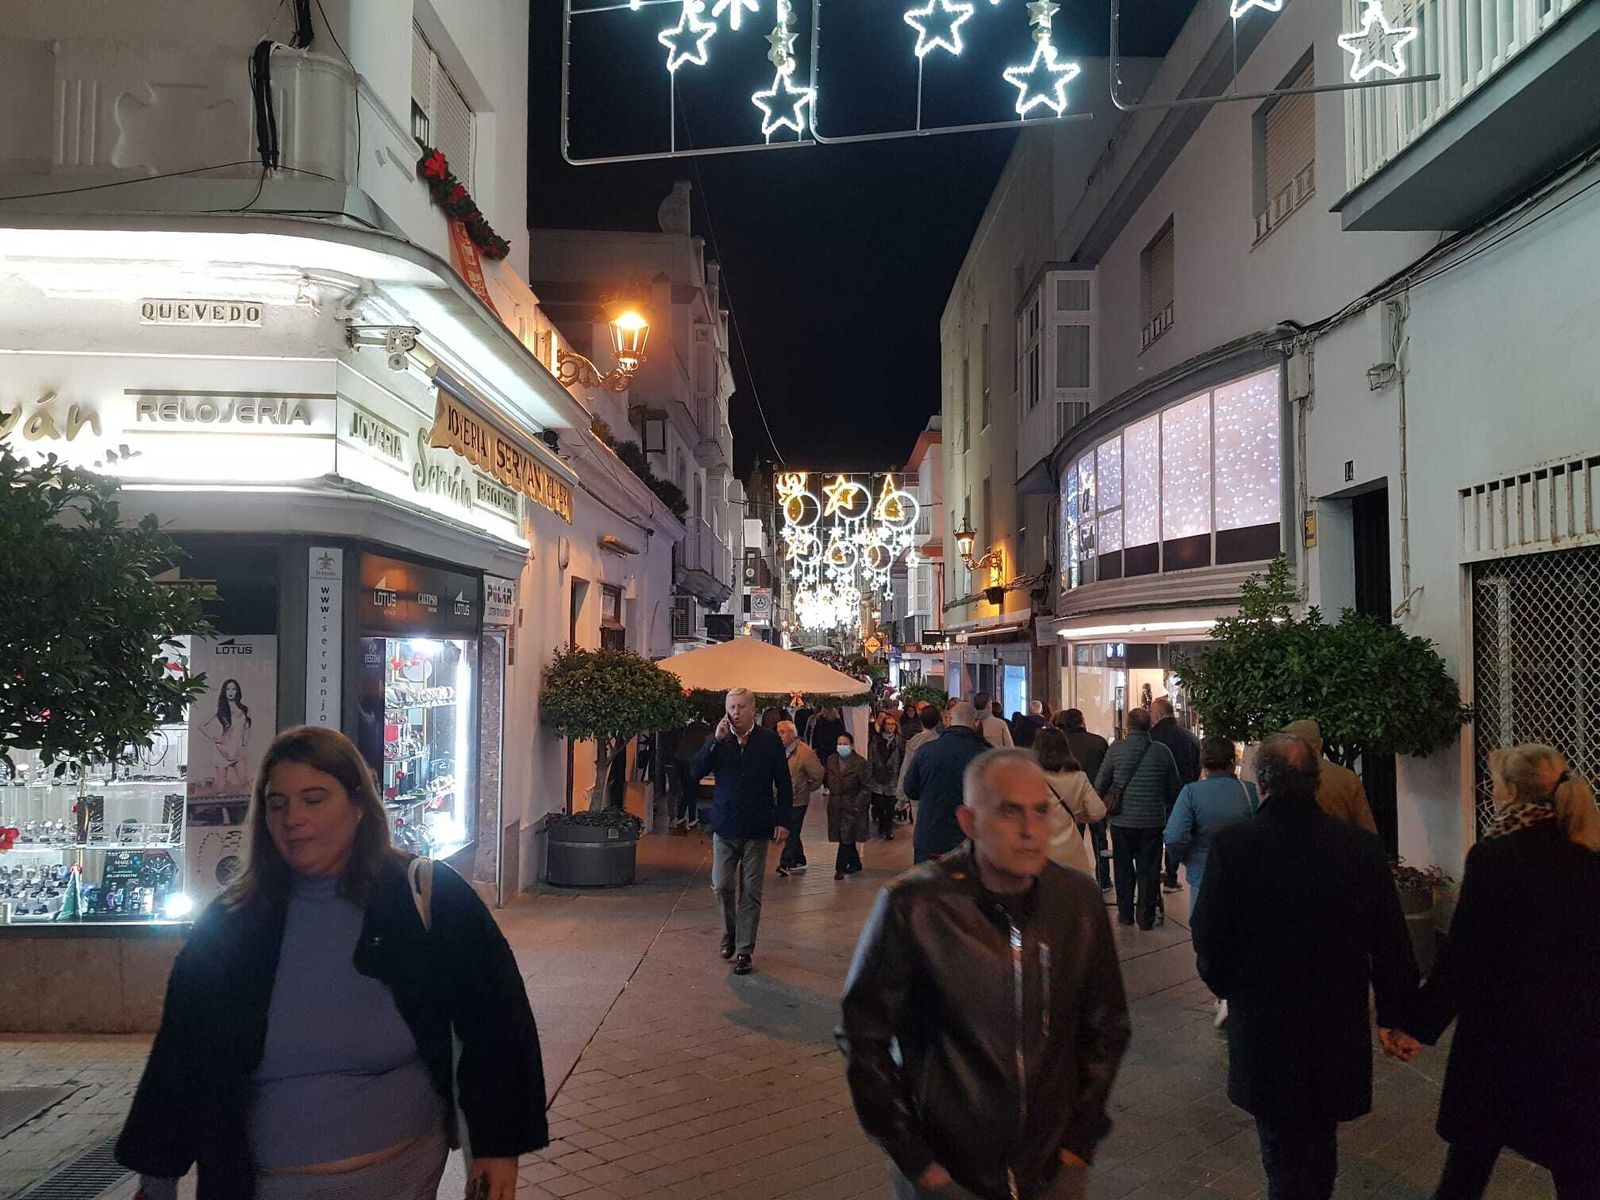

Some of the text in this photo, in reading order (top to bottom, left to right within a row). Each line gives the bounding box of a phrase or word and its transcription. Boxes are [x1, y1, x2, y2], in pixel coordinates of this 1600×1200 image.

[141, 302, 260, 322] QUEVEDO
[447, 404, 488, 458] JOYERIA
[496, 438, 542, 493] SERVAN
[373, 591, 398, 608] LOTUS
[454, 602, 471, 616] LOTUS
[215, 646, 253, 655] LOTUS
